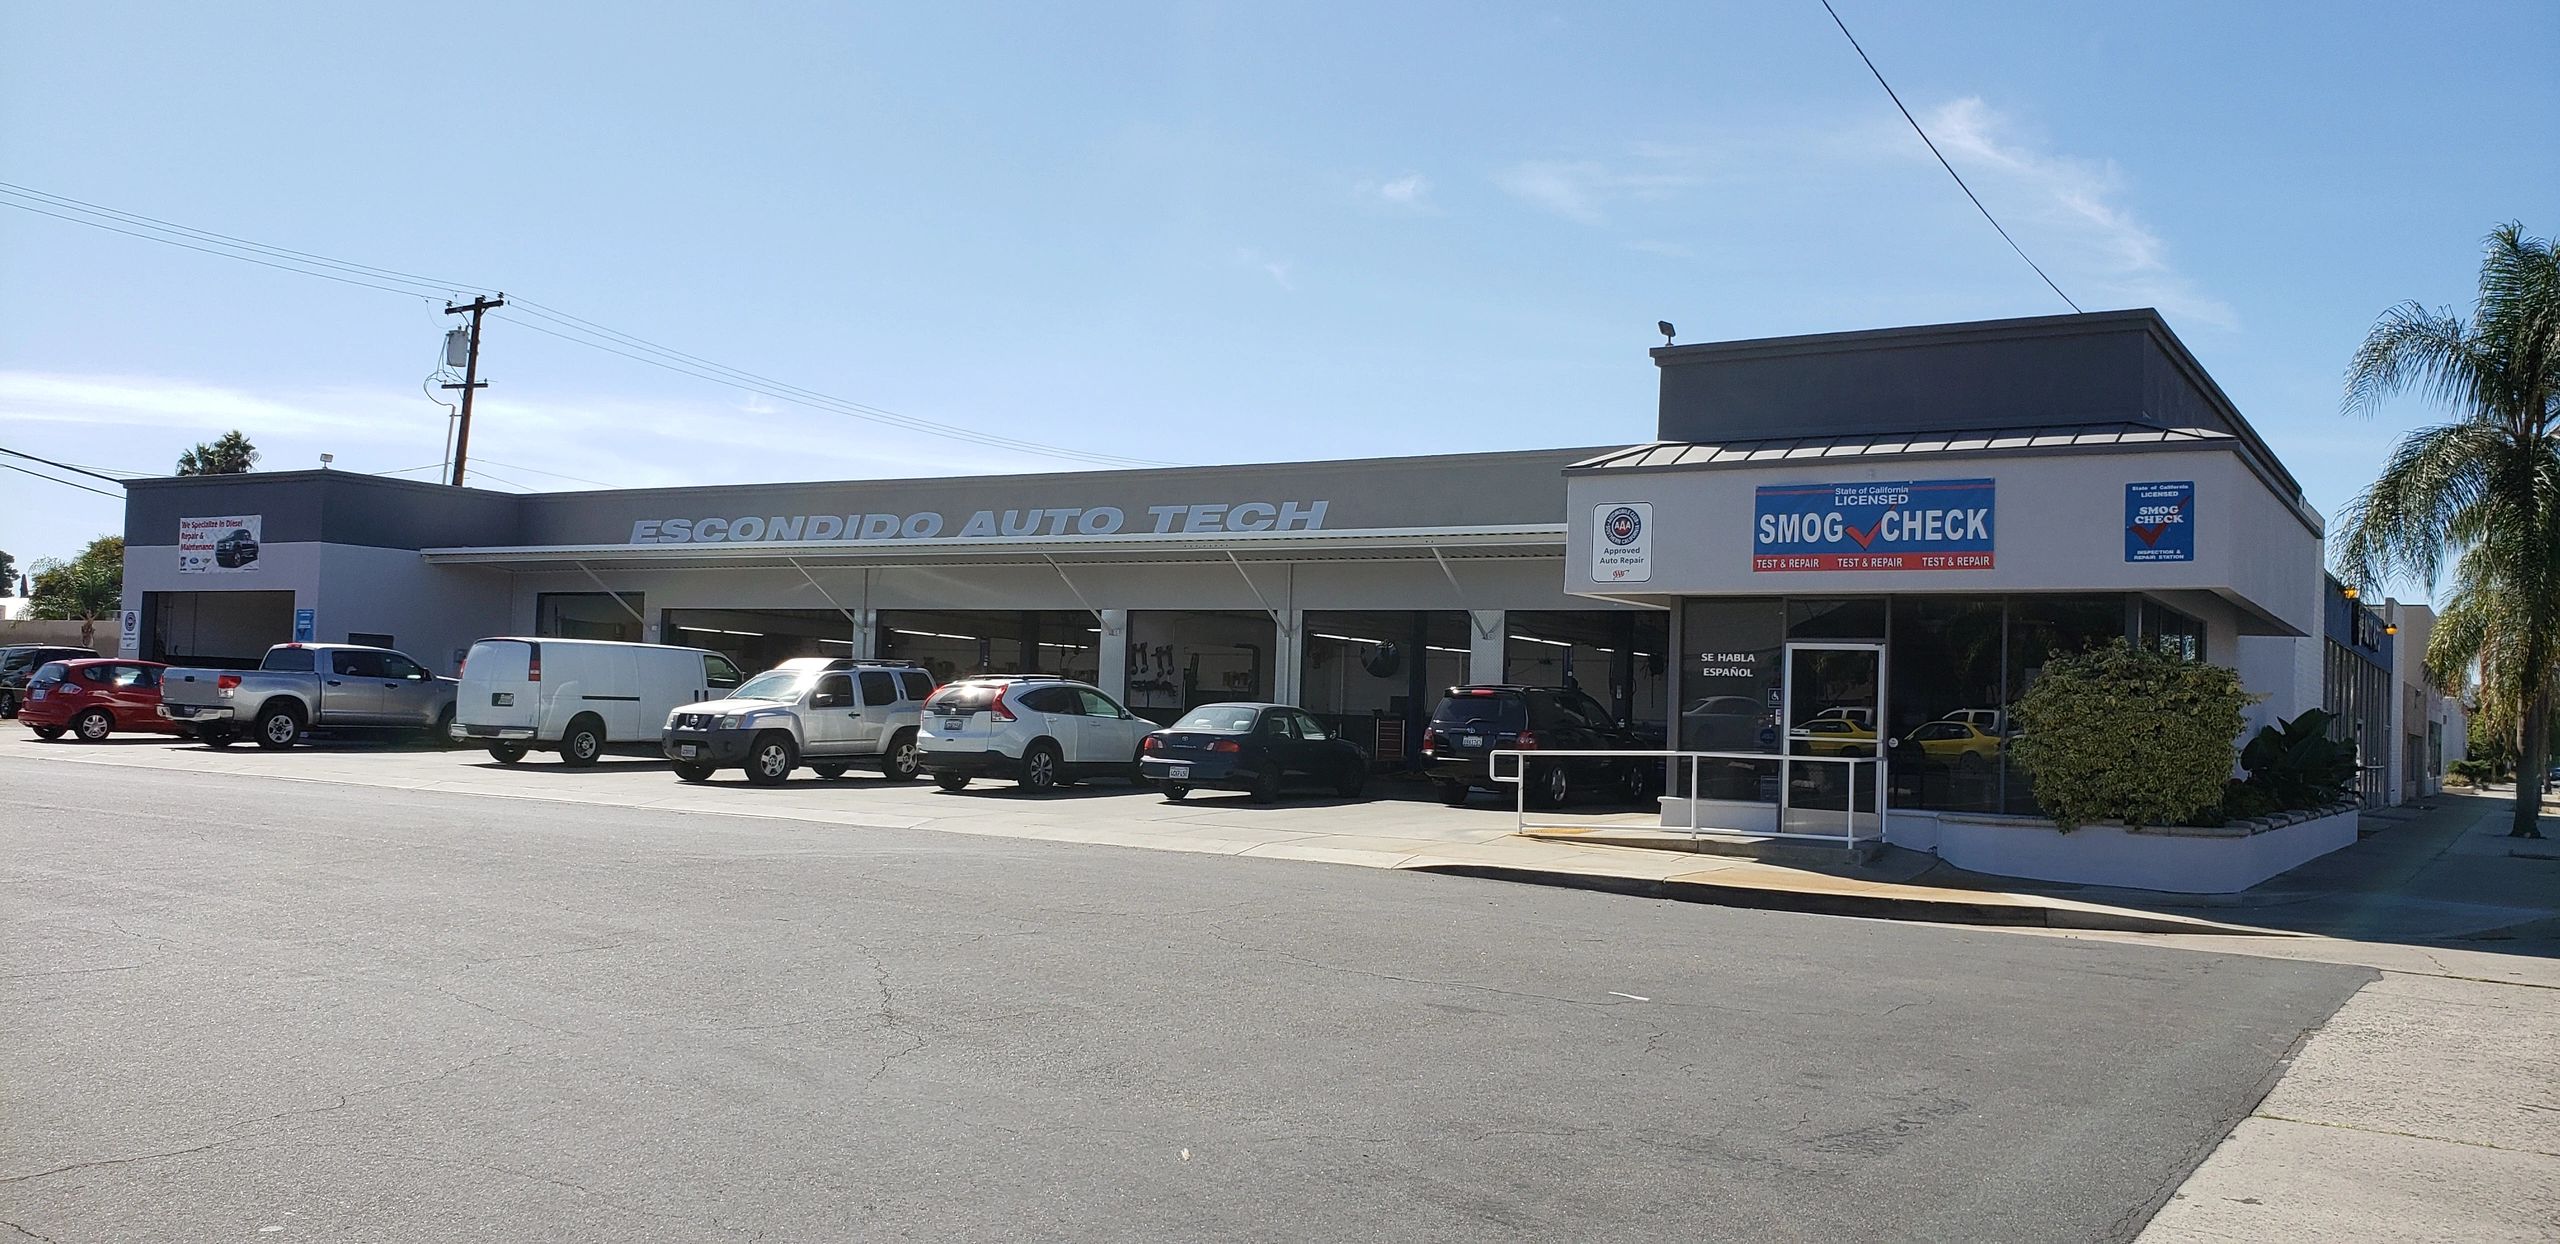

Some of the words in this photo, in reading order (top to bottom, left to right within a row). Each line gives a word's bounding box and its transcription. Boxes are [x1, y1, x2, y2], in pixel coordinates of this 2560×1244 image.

[1858, 487, 1868, 495] of
[1869, 485, 1909, 494] California
[1835, 494, 1909, 506] LICENSED
[2139, 506, 2180, 515] SMOG
[629, 511, 944, 544] ESCONDIDO
[956, 506, 1125, 538] AUTO
[1148, 500, 1330, 534] TECH
[2134, 515, 2184, 523] CHECK
[191, 520, 218, 530] Specialize
[226, 519, 243, 528] Diesel
[1614, 520, 1631, 531] AAA
[1759, 512, 1844, 545] SMOG
[1880, 508, 1989, 542] CHECK
[181, 532, 199, 541] Repair
[1604, 547, 1641, 555] Approved
[1620, 557, 1644, 565] Repair
[1757, 559, 1778, 568] TEST
[1780, 559, 1787, 567] &
[1788, 558, 1819, 568] REPAIR
[1837, 558, 1860, 568] TEST
[1861, 558, 1868, 567] &
[1870, 557, 1903, 567] REPAIR
[1922, 557, 1946, 567] TEST
[1947, 557, 1955, 566] &
[1956, 556, 1990, 566] REPAIR
[1701, 653, 1715, 662] SE
[1717, 653, 1756, 662] HABLA
[1703, 666, 1753, 677] ESPAÑOL
